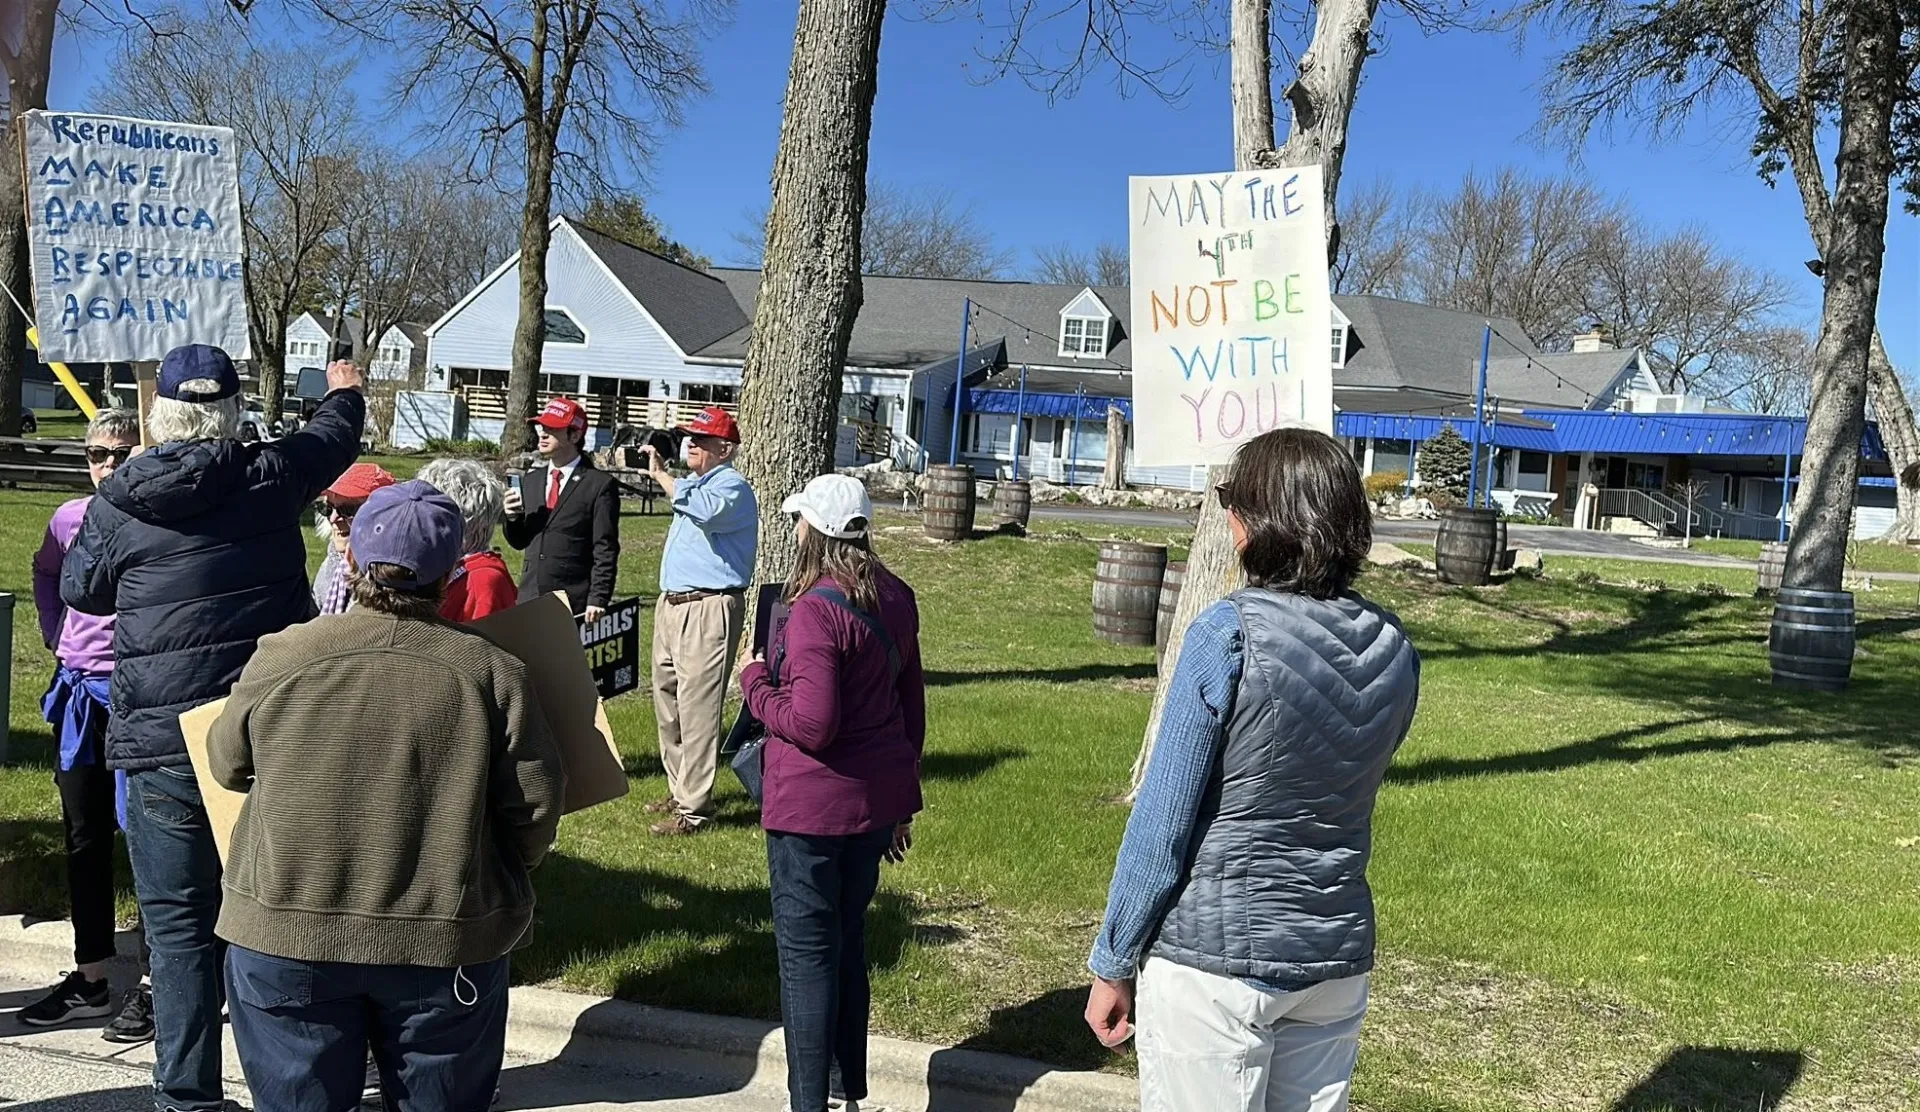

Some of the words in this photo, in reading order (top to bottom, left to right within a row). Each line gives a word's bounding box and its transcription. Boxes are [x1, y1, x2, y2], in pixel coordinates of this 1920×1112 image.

[52, 115, 219, 155] Republicans
[40, 155, 168, 188] MAKE
[45, 196, 215, 232] AMERICA
[1143, 174, 1233, 228] MAY
[1244, 173, 1305, 220] THE
[52, 246, 243, 282] RESPECTABLE
[1198, 230, 1254, 278] 4TH
[62, 293, 188, 325] AGAIN
[1151, 279, 1238, 333] NOT
[1255, 273, 1305, 322] BE
[1169, 336, 1289, 382] WITH
[580, 606, 637, 646] GIRLS'
[584, 637, 624, 670] RTS!
